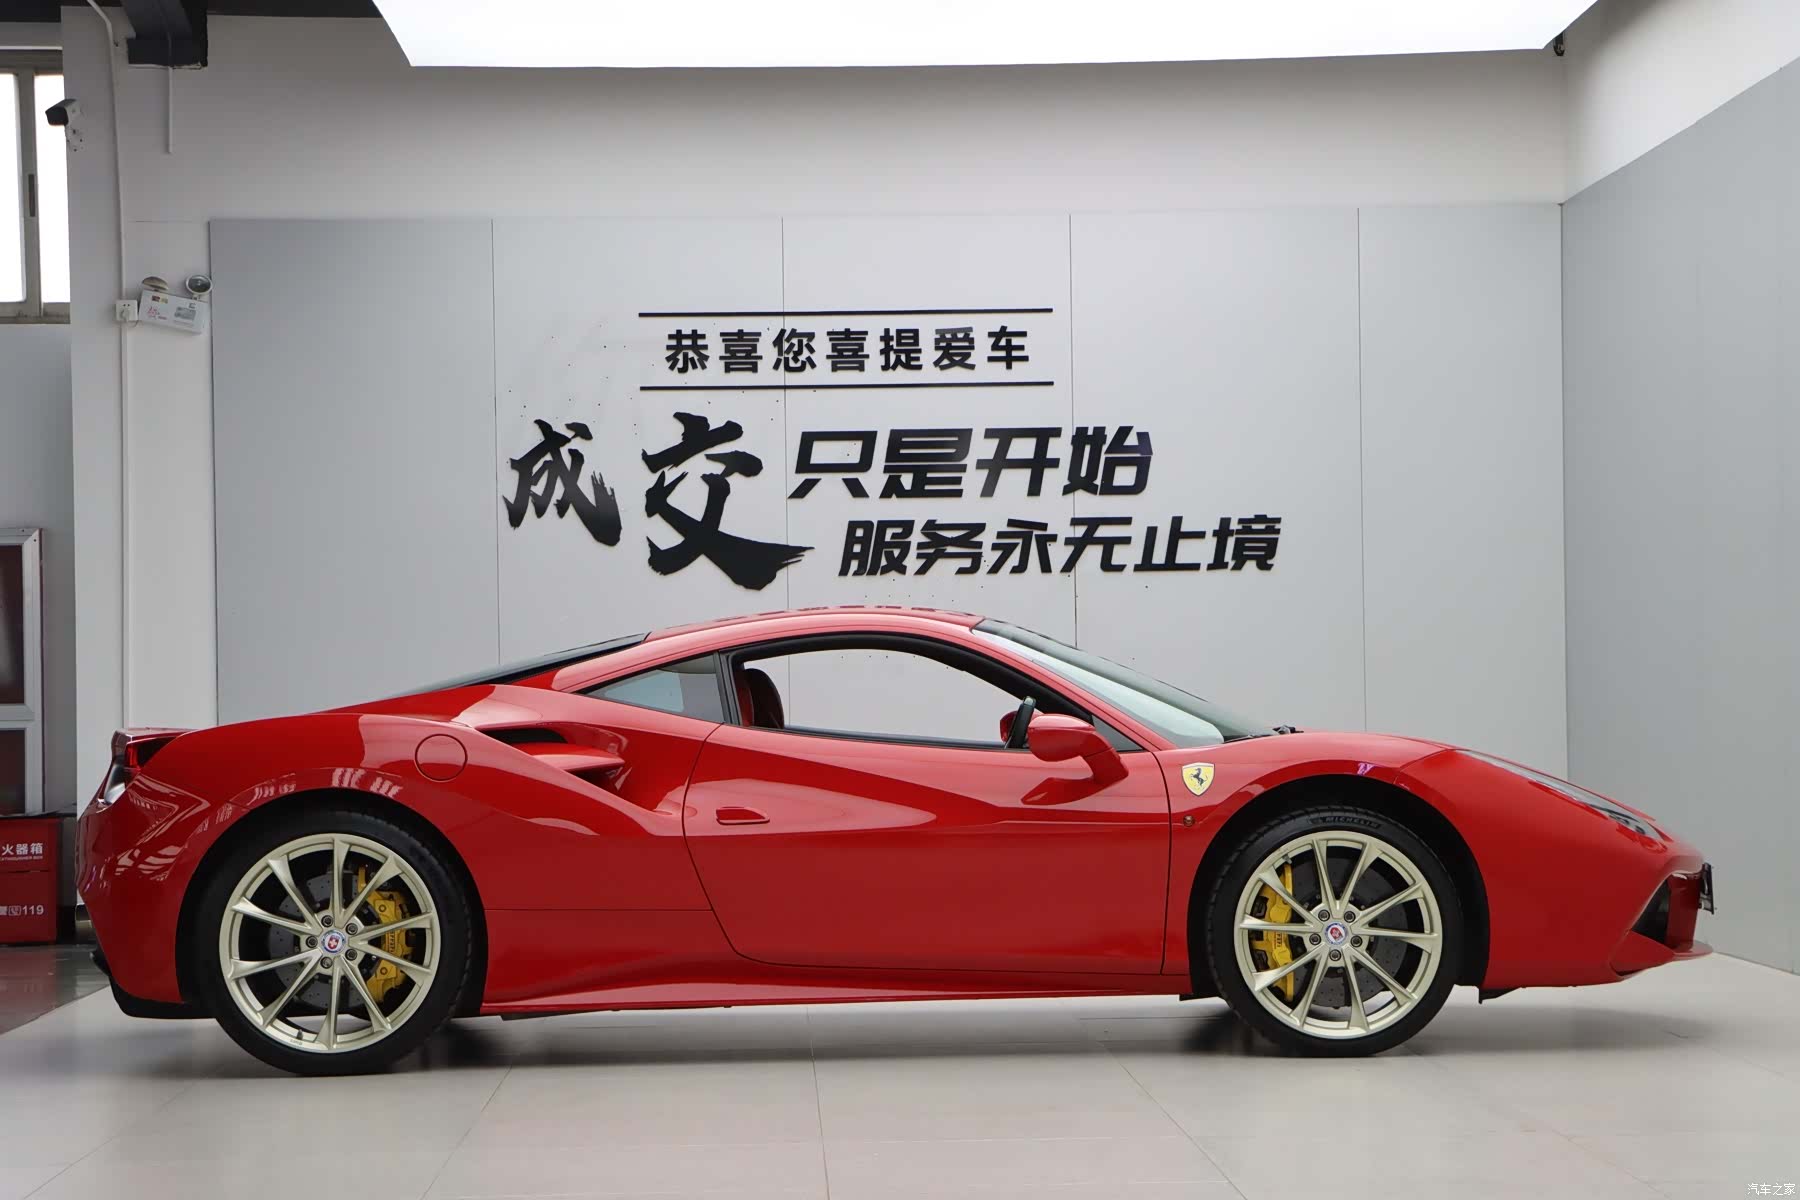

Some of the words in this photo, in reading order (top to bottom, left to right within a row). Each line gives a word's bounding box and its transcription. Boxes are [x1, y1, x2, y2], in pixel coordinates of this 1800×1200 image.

[665, 326, 1029, 374] 恭喜您喜提爱车
[502, 411, 813, 591] 成交
[787, 425, 1153, 499] 只是开始
[839, 514, 1281, 577] 服务永无止境
[22, 904, 44, 915] 119
